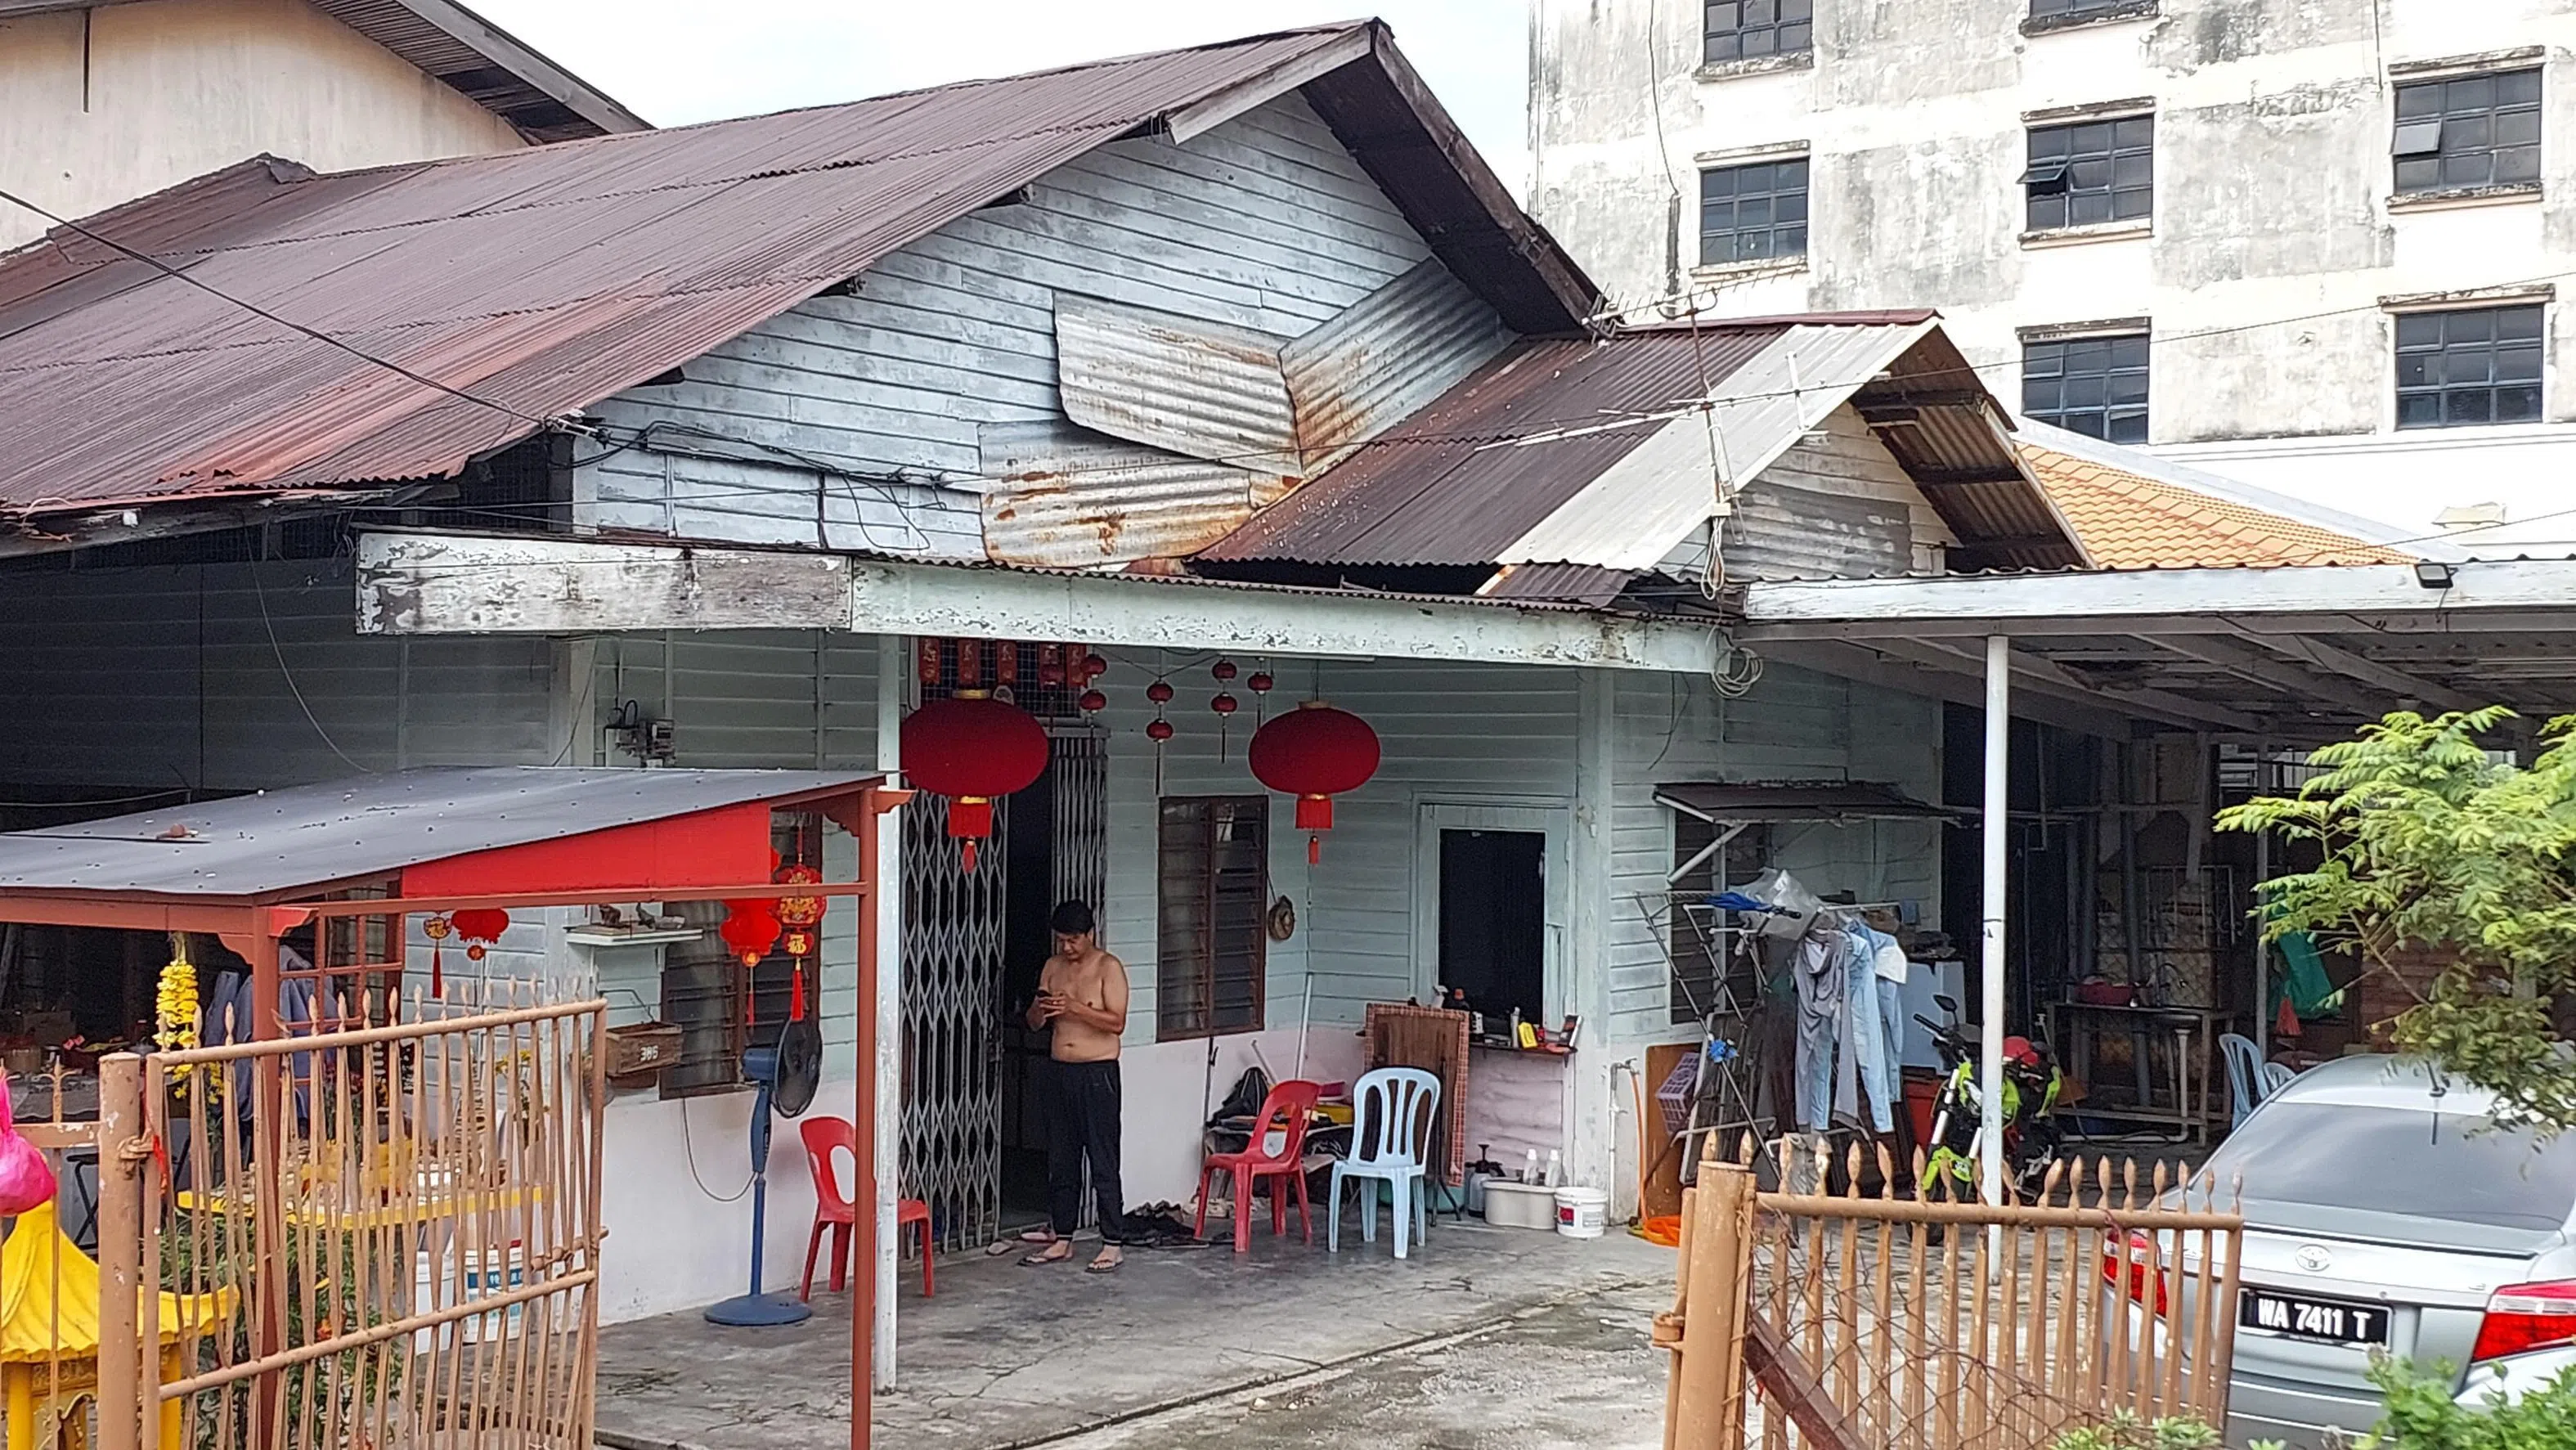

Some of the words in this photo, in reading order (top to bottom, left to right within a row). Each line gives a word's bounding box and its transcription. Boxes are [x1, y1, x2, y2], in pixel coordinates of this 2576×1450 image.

[2258, 1298, 2290, 1329] WA
[2294, 1303, 2344, 1336] 7411
[2352, 1311, 2372, 1339] T
